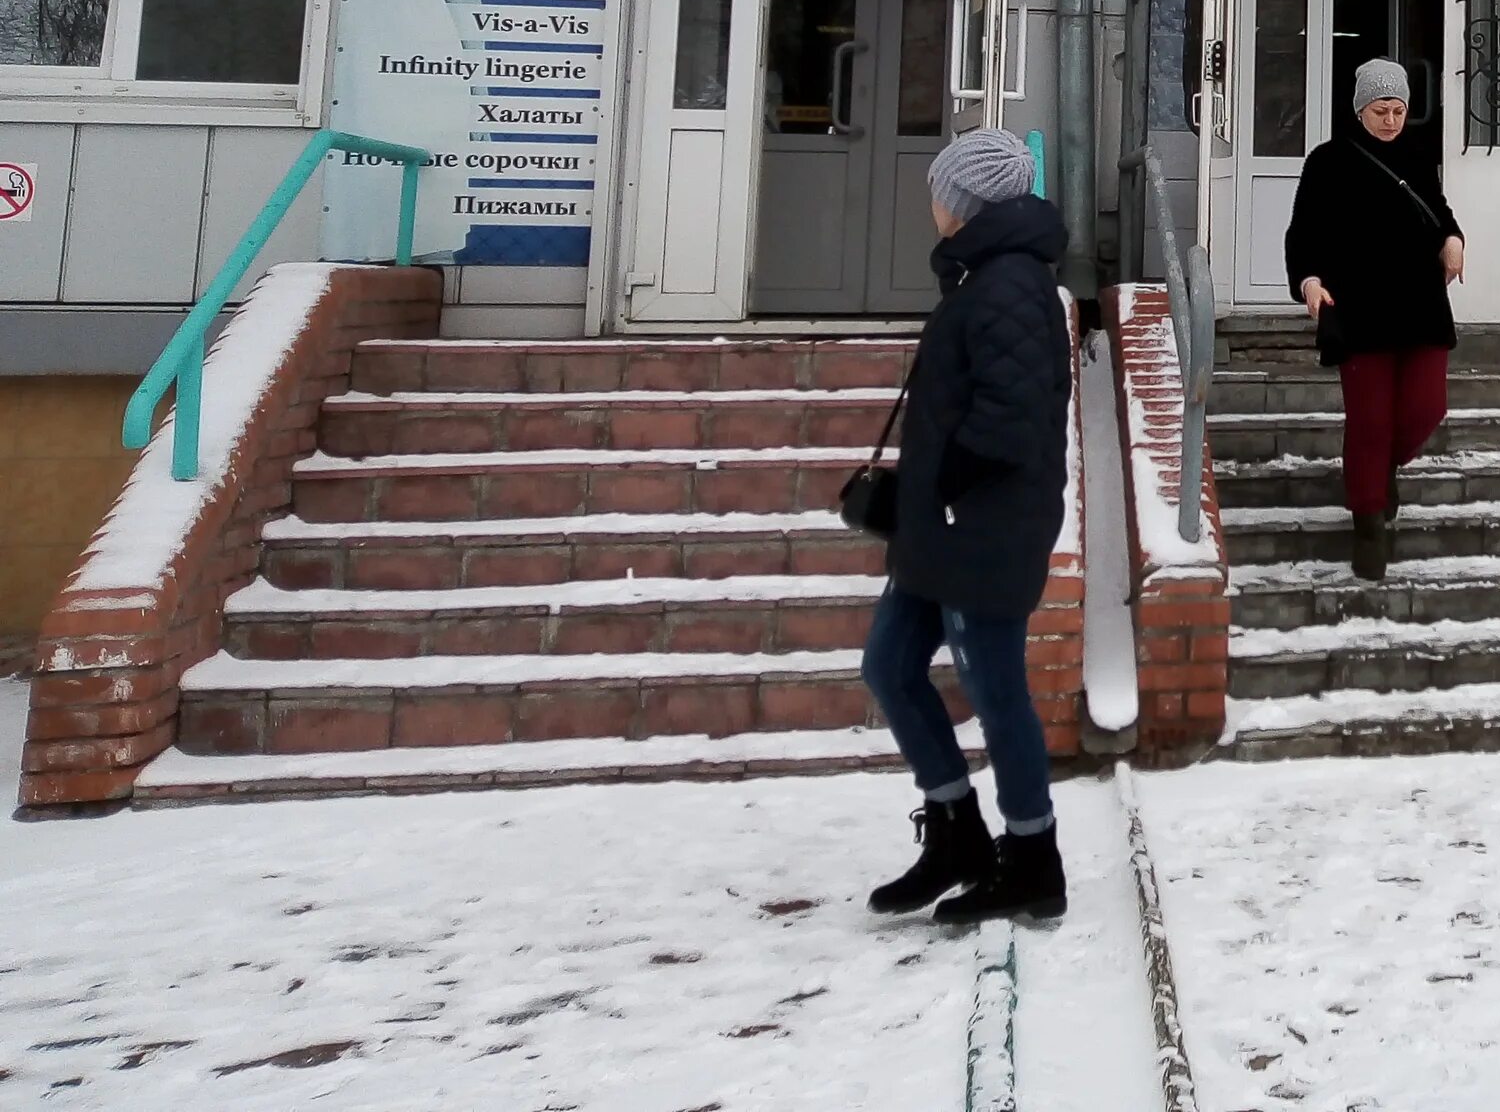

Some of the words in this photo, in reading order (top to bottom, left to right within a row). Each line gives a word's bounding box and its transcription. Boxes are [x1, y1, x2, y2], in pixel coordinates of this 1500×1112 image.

[472, 13, 589, 35] Vis-a-Vis
[378, 55, 479, 81] Infinity
[485, 57, 586, 83] lingerie
[477, 104, 583, 125] Халаты
[341, 152, 458, 168] Ноые
[465, 154, 579, 173] сорочки
[452, 195, 577, 216] Пижамы
